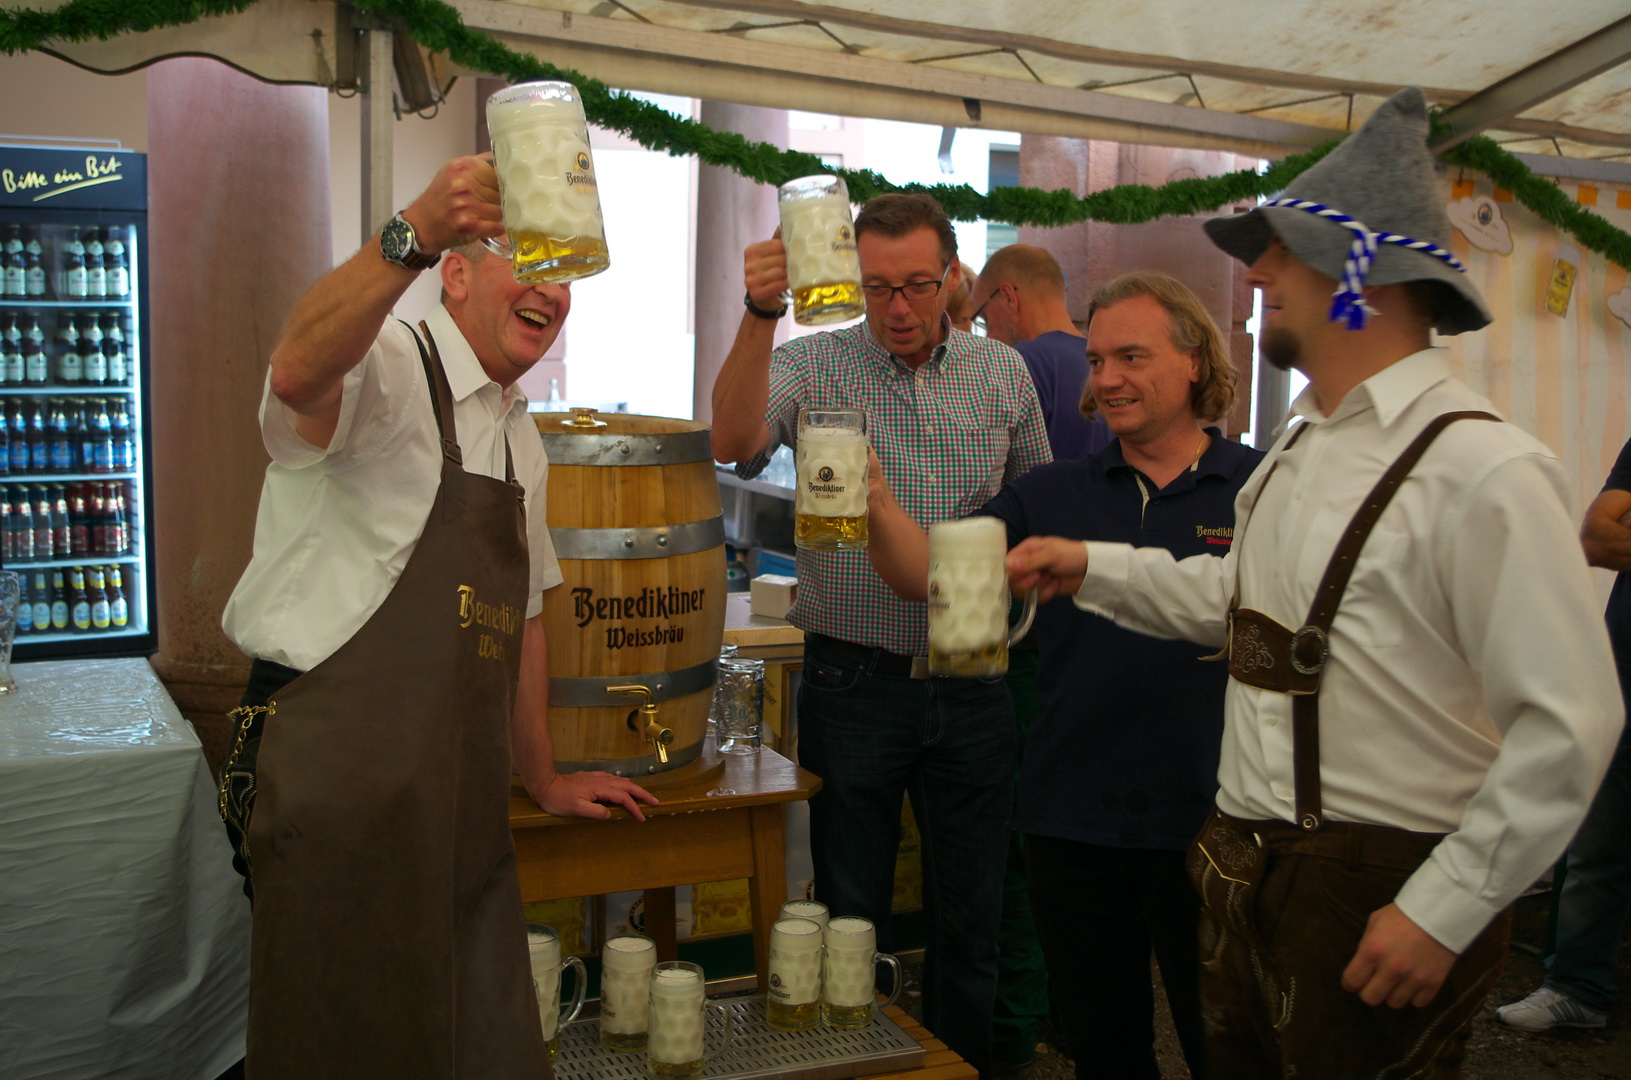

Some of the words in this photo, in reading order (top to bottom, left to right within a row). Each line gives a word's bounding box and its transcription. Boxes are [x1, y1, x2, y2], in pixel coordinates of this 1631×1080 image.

[2, 168, 48, 193] Bitte
[54, 168, 83, 184] ein
[85, 155, 122, 178] Bit
[808, 482, 845, 493] Benediktiner
[570, 586, 705, 628] Benediktiner
[478, 633, 505, 660] Wei
[606, 625, 684, 650] Weissbräu
